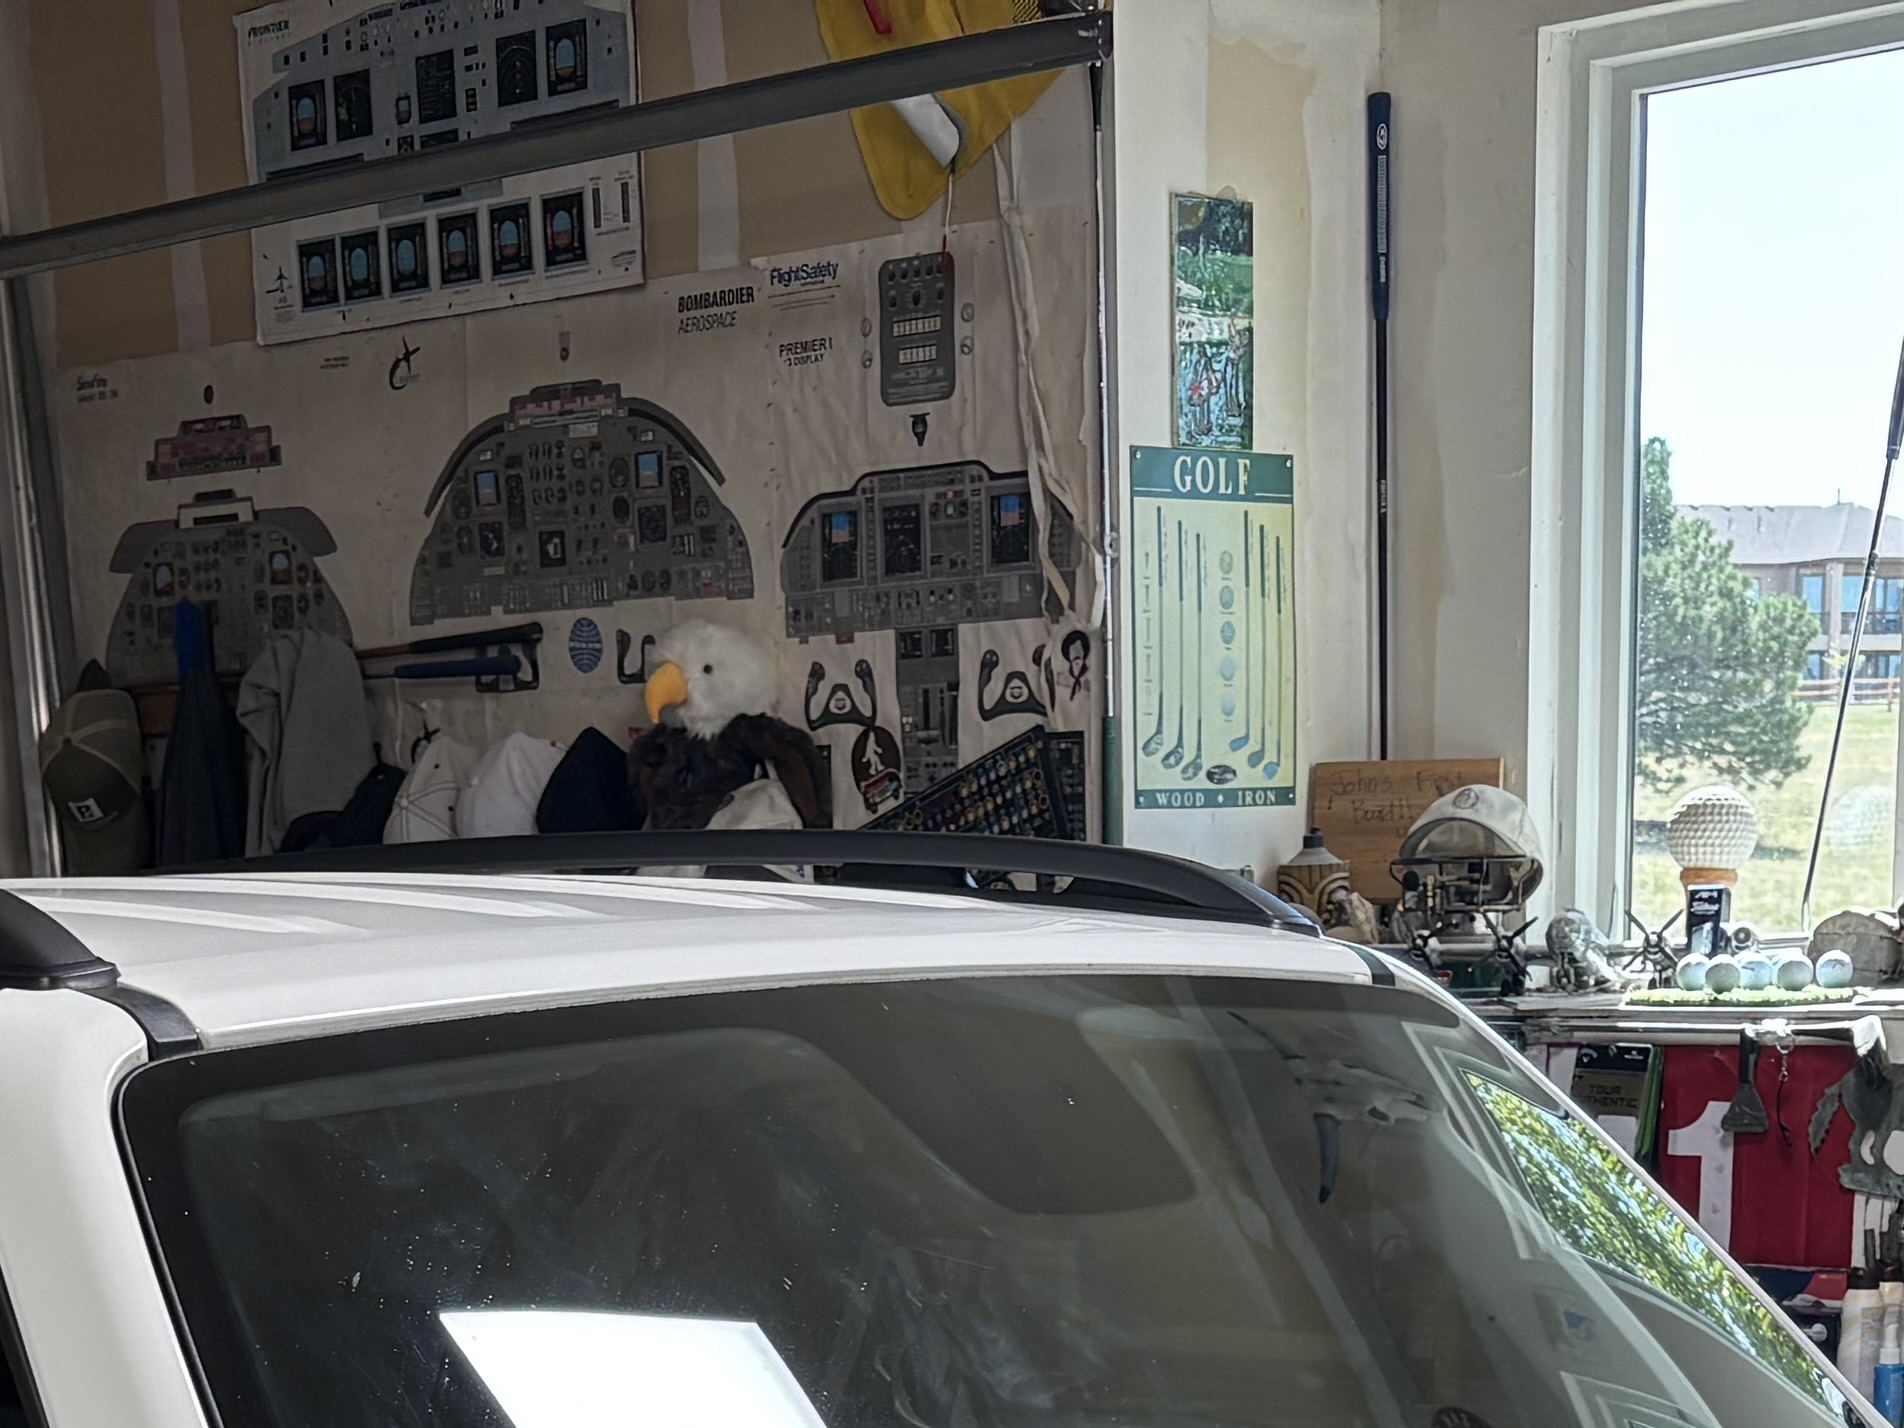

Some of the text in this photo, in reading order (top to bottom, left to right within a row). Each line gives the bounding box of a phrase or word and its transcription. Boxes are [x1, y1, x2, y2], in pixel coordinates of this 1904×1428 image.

[678, 286, 755, 313] BOMBARDIER
[678, 311, 737, 335] AEROSPACE
[779, 338, 827, 358] PREMIER
[1174, 456, 1250, 495] GOLF
[1156, 790, 1276, 807] WOOD IRON
[1579, 1096, 1637, 1108] THENTIC
